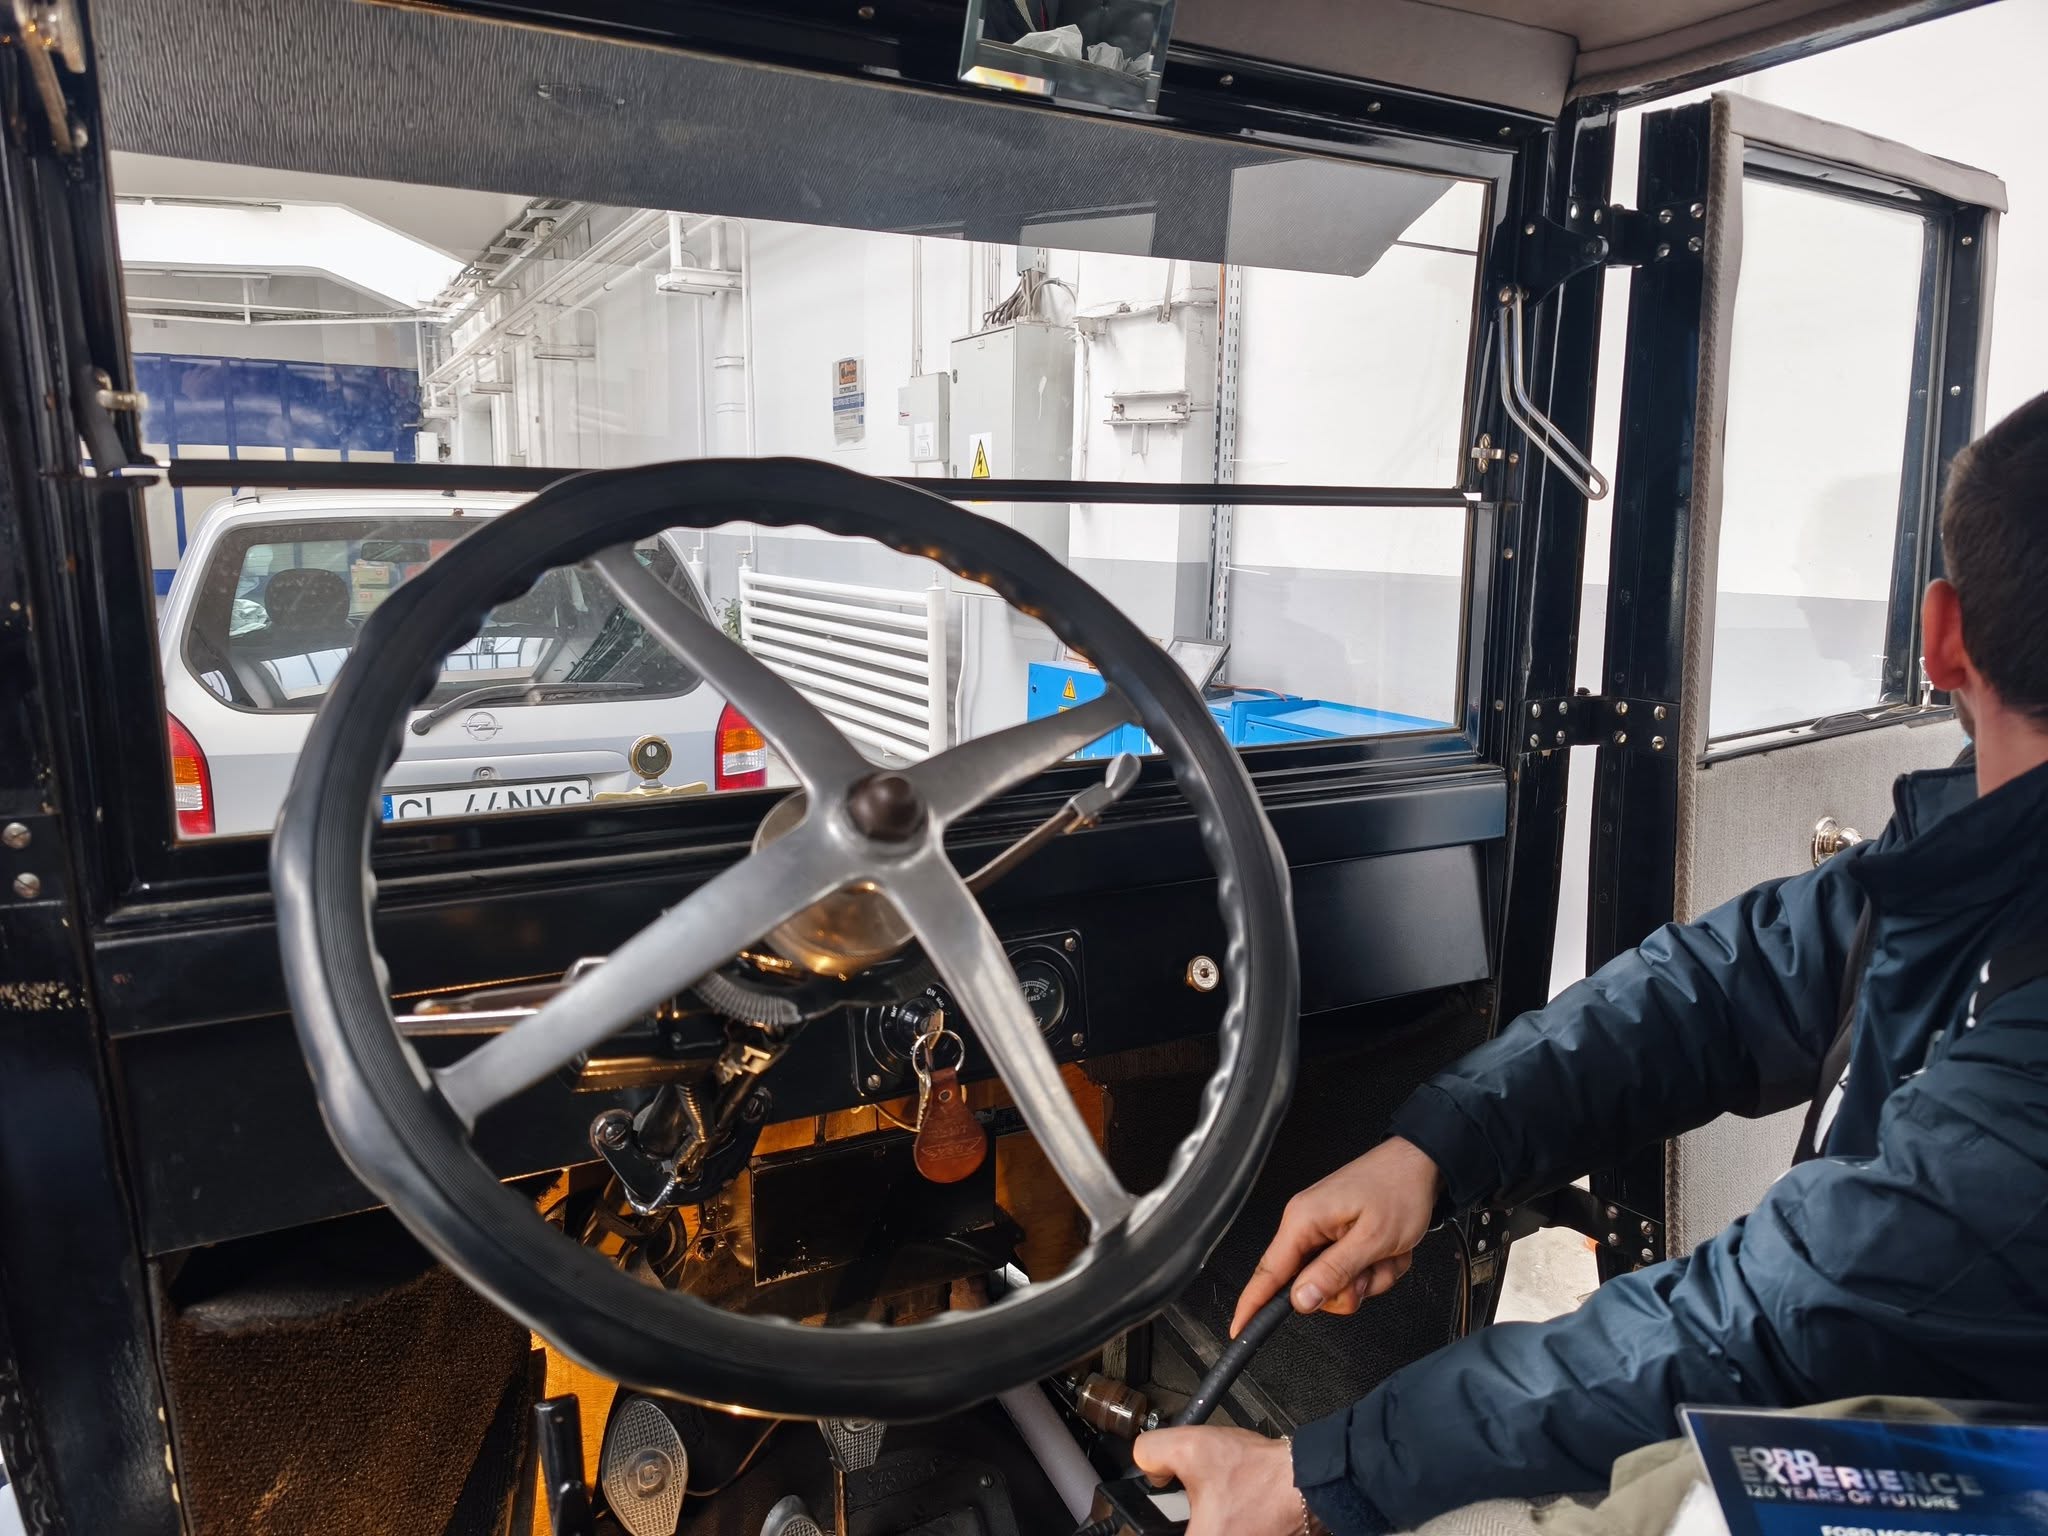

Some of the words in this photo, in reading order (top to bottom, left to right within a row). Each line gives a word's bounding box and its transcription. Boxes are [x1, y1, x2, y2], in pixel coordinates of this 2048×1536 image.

[1730, 1446, 1819, 1467] FORD
[1738, 1462, 1984, 1496] EXPERIENCE
[1744, 1484, 1777, 1498] 120
[1779, 1486, 1846, 1502] YEARS
[1848, 1489, 1875, 1505] OF
[1879, 1491, 1961, 1511] FUTURE
